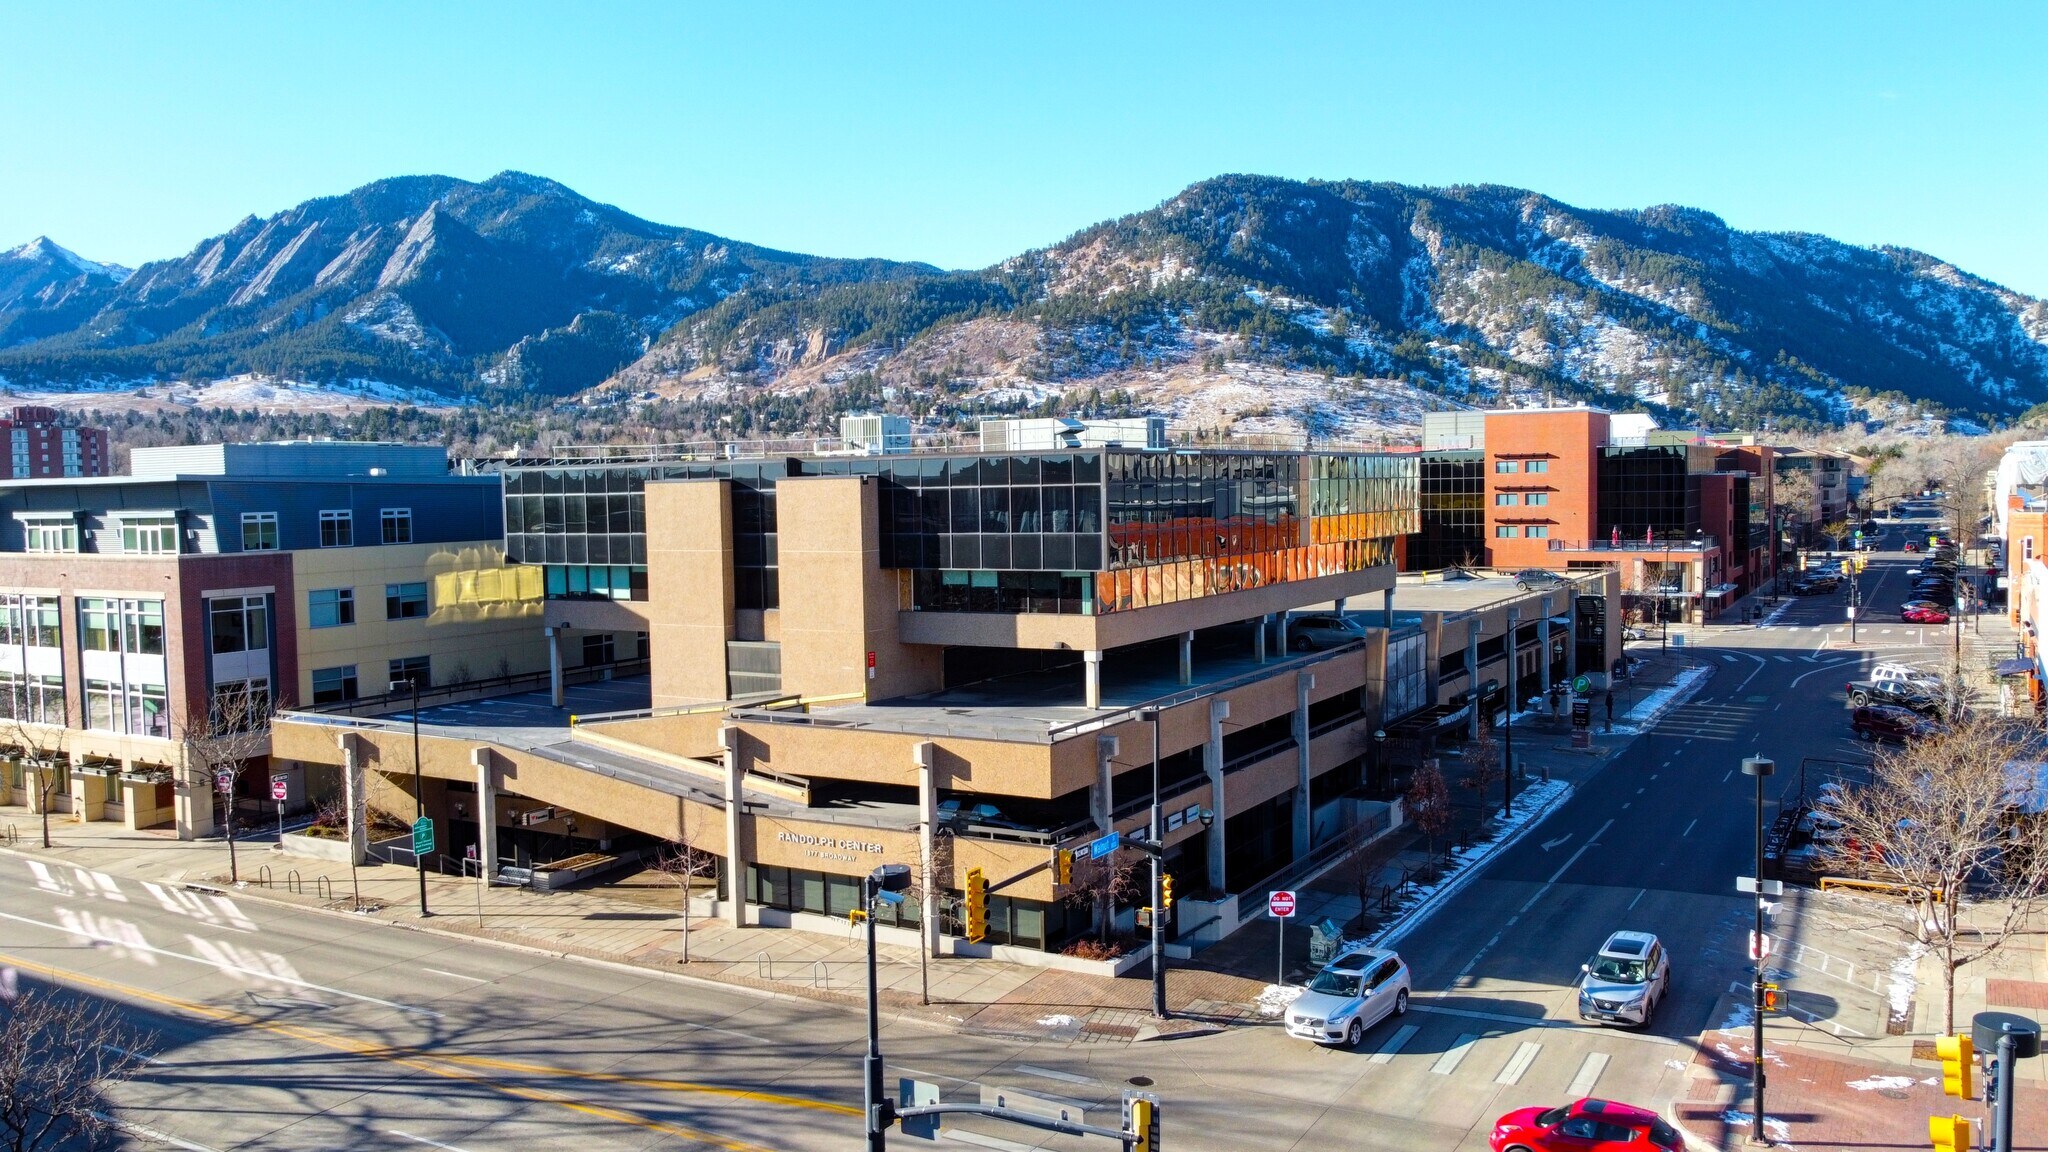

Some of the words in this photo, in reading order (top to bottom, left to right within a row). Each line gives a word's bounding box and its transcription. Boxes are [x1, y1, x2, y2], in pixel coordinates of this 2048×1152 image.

[778, 832, 835, 848] RANDOLPH
[840, 840, 883, 853] CENTER
[820, 852, 857, 862] BROADWAY
